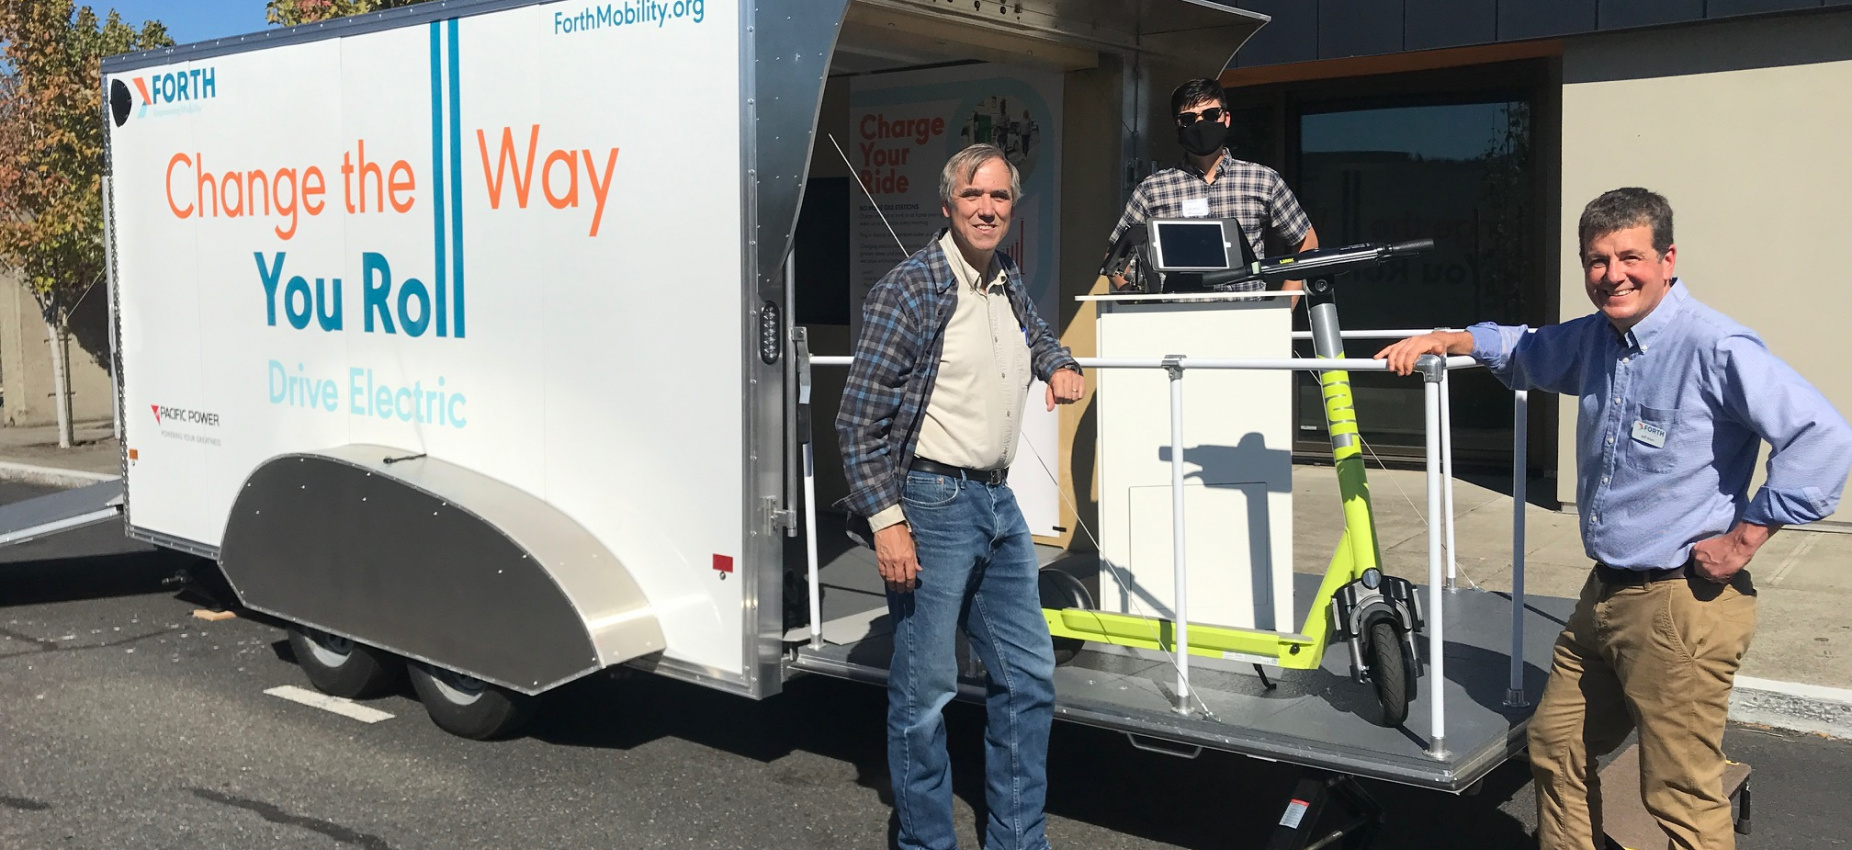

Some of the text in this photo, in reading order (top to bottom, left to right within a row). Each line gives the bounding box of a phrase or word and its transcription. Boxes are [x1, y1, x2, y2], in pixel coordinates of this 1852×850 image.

[554, 0, 704, 34] ForthMobility.org
[152, 67, 216, 105] FORTH
[860, 113, 945, 145] Charge
[859, 141, 910, 167] Your
[165, 124, 620, 241] Change the Way
[860, 168, 910, 194] Ride
[253, 251, 344, 333] You
[268, 359, 468, 430] Drive Electric
[160, 406, 220, 427] PACIFIC POWER
[1644, 424, 1665, 438] FORTH
